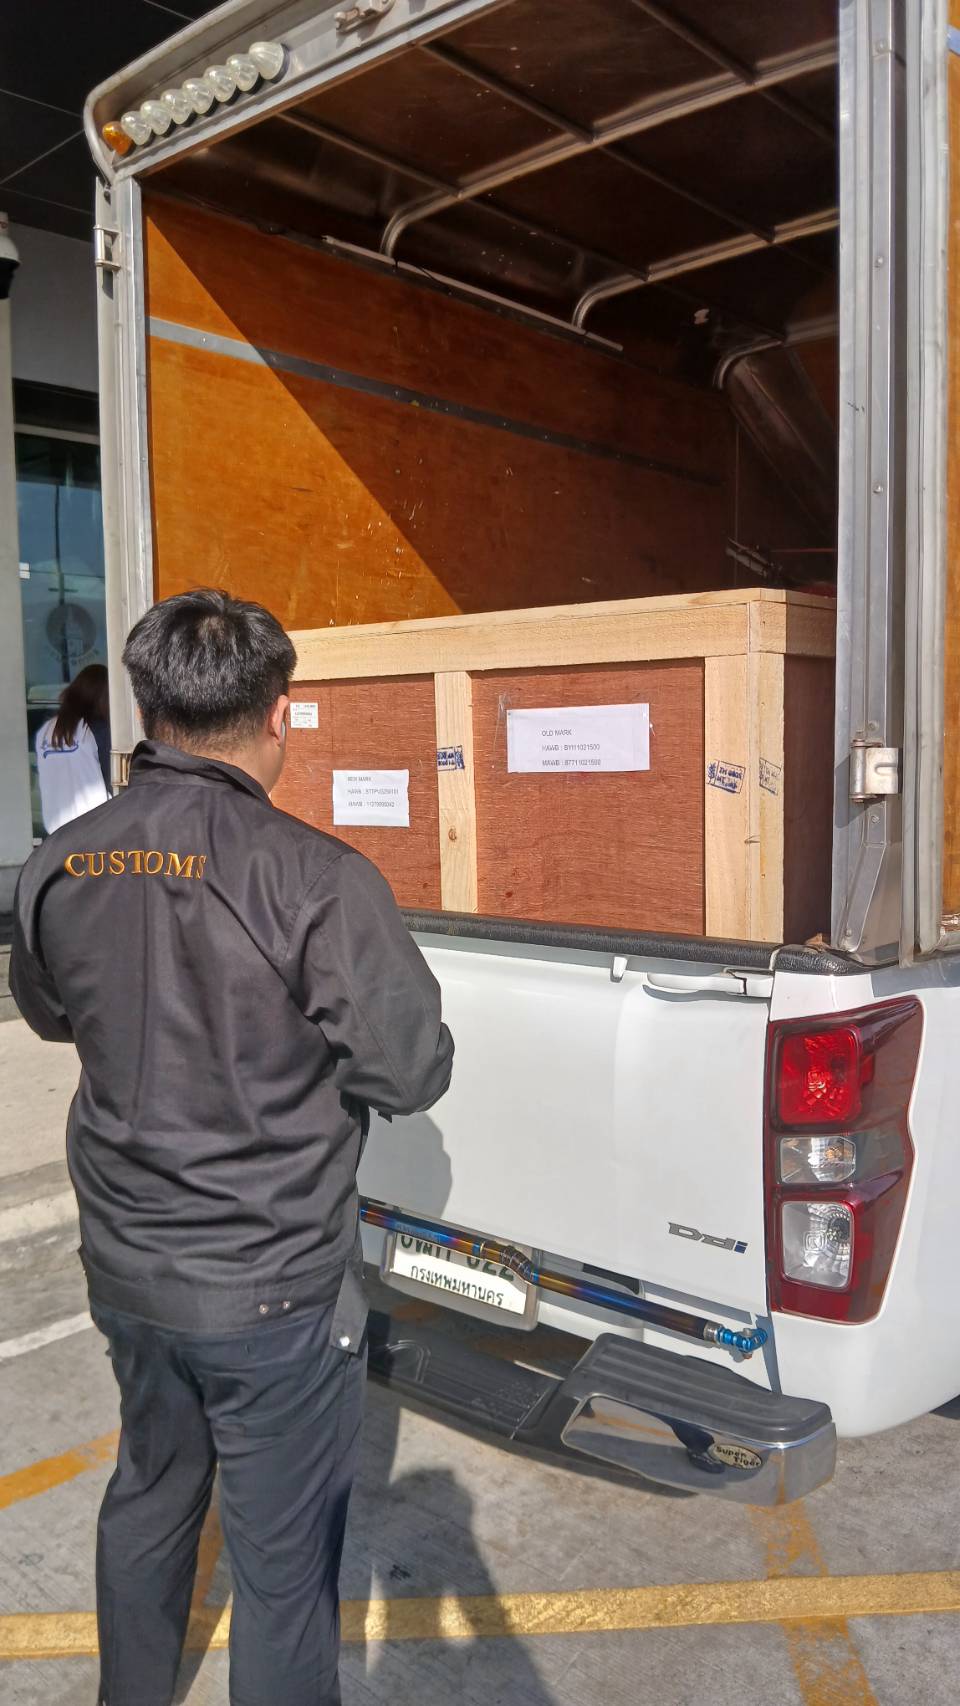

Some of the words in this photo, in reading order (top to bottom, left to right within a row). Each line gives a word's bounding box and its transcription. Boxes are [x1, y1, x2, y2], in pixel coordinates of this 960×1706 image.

[64, 850, 207, 879] CUSTOMS
[410, 1265, 505, 1306] กรงเทพมหานคร
[716, 1446, 747, 1458] Super
